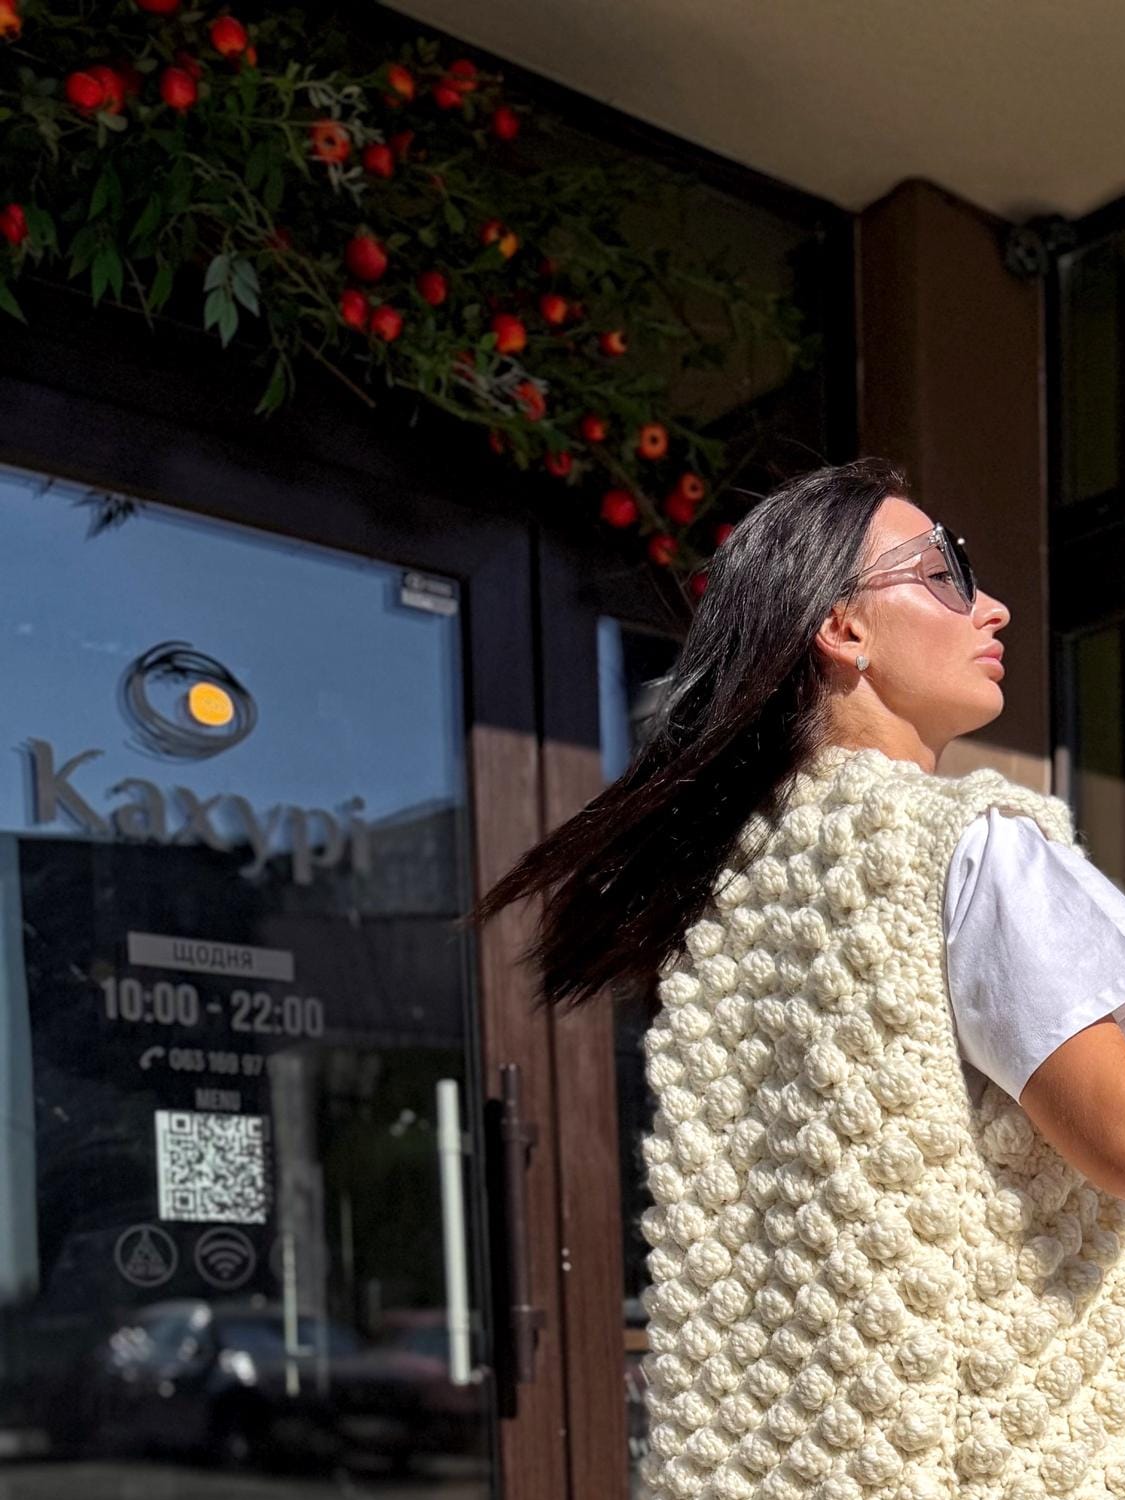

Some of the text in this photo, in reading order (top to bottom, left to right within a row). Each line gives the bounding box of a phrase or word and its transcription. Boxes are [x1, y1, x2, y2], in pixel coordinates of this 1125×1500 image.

[18, 737, 371, 885] Кахурі
[173, 942, 254, 970] ЩОДНЯ
[100, 976, 199, 1027] 10:00
[230, 989, 325, 1038] 22:00
